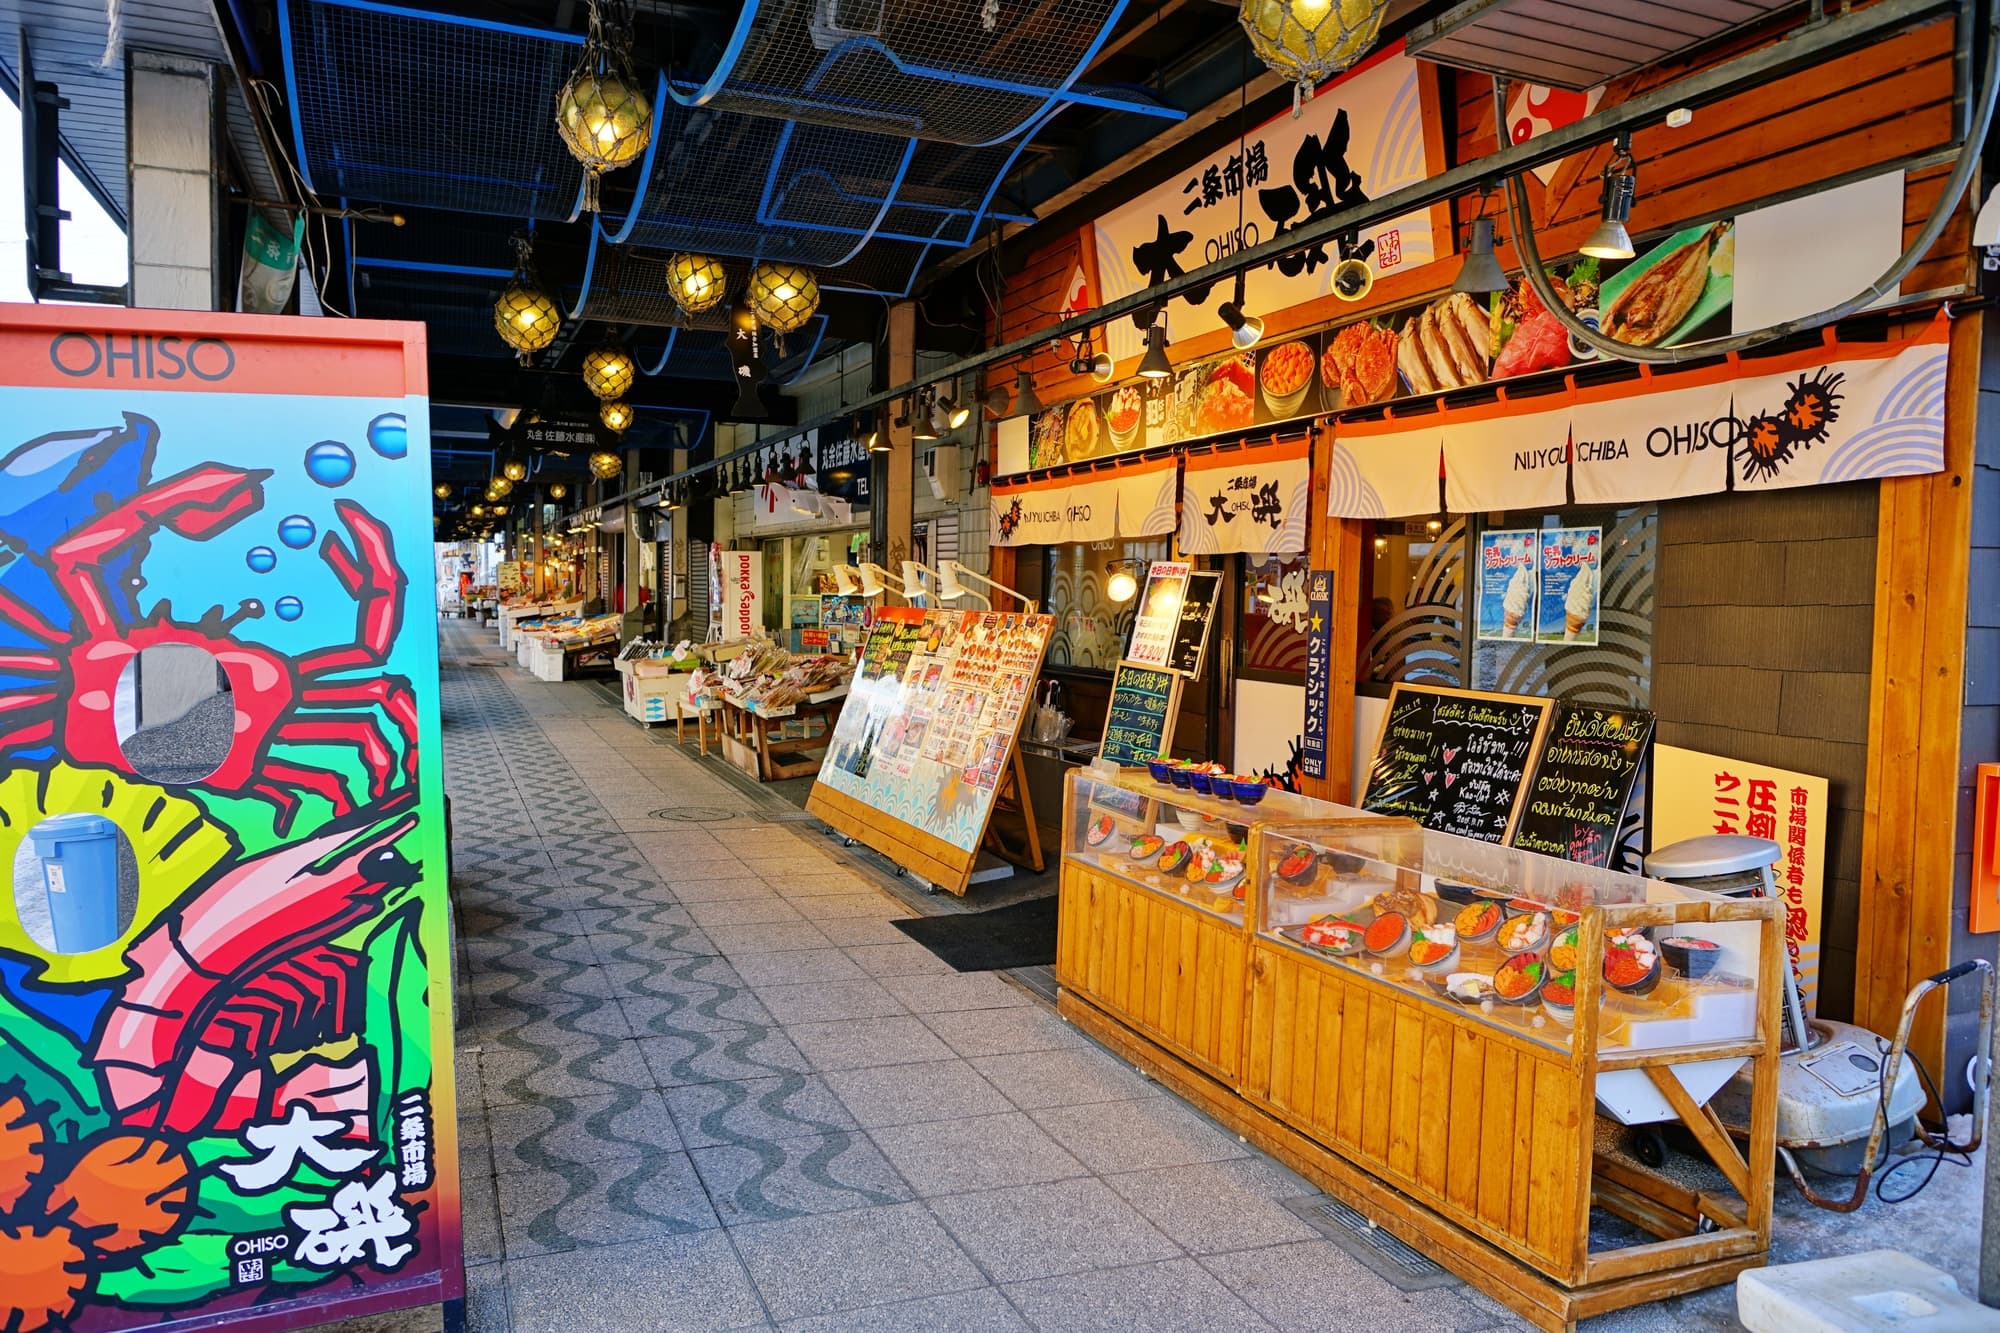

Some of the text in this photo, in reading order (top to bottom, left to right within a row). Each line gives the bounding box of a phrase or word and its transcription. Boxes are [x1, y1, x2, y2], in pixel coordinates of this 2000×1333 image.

[1183, 140, 1269, 216] 二条市場
[50, 332, 236, 381] OHISO
[1514, 417, 1743, 471] NIJYOU ICHIBA OHISO
[857, 477, 869, 496] TEL
[1485, 546, 1500, 558] 牛乳
[1485, 552, 1532, 569] ソフトクリーム
[1544, 545, 1561, 557] 牛乳
[1544, 552, 1596, 570] ソフトクリーム
[1310, 591, 1329, 601] CLASSIC
[738, 592, 755, 636] sappor
[1307, 637, 1321, 733] クラシック
[1304, 757, 1322, 768] ONLY
[399, 1094, 427, 1186] 二条市場
[234, 1234, 289, 1256] OHISO
